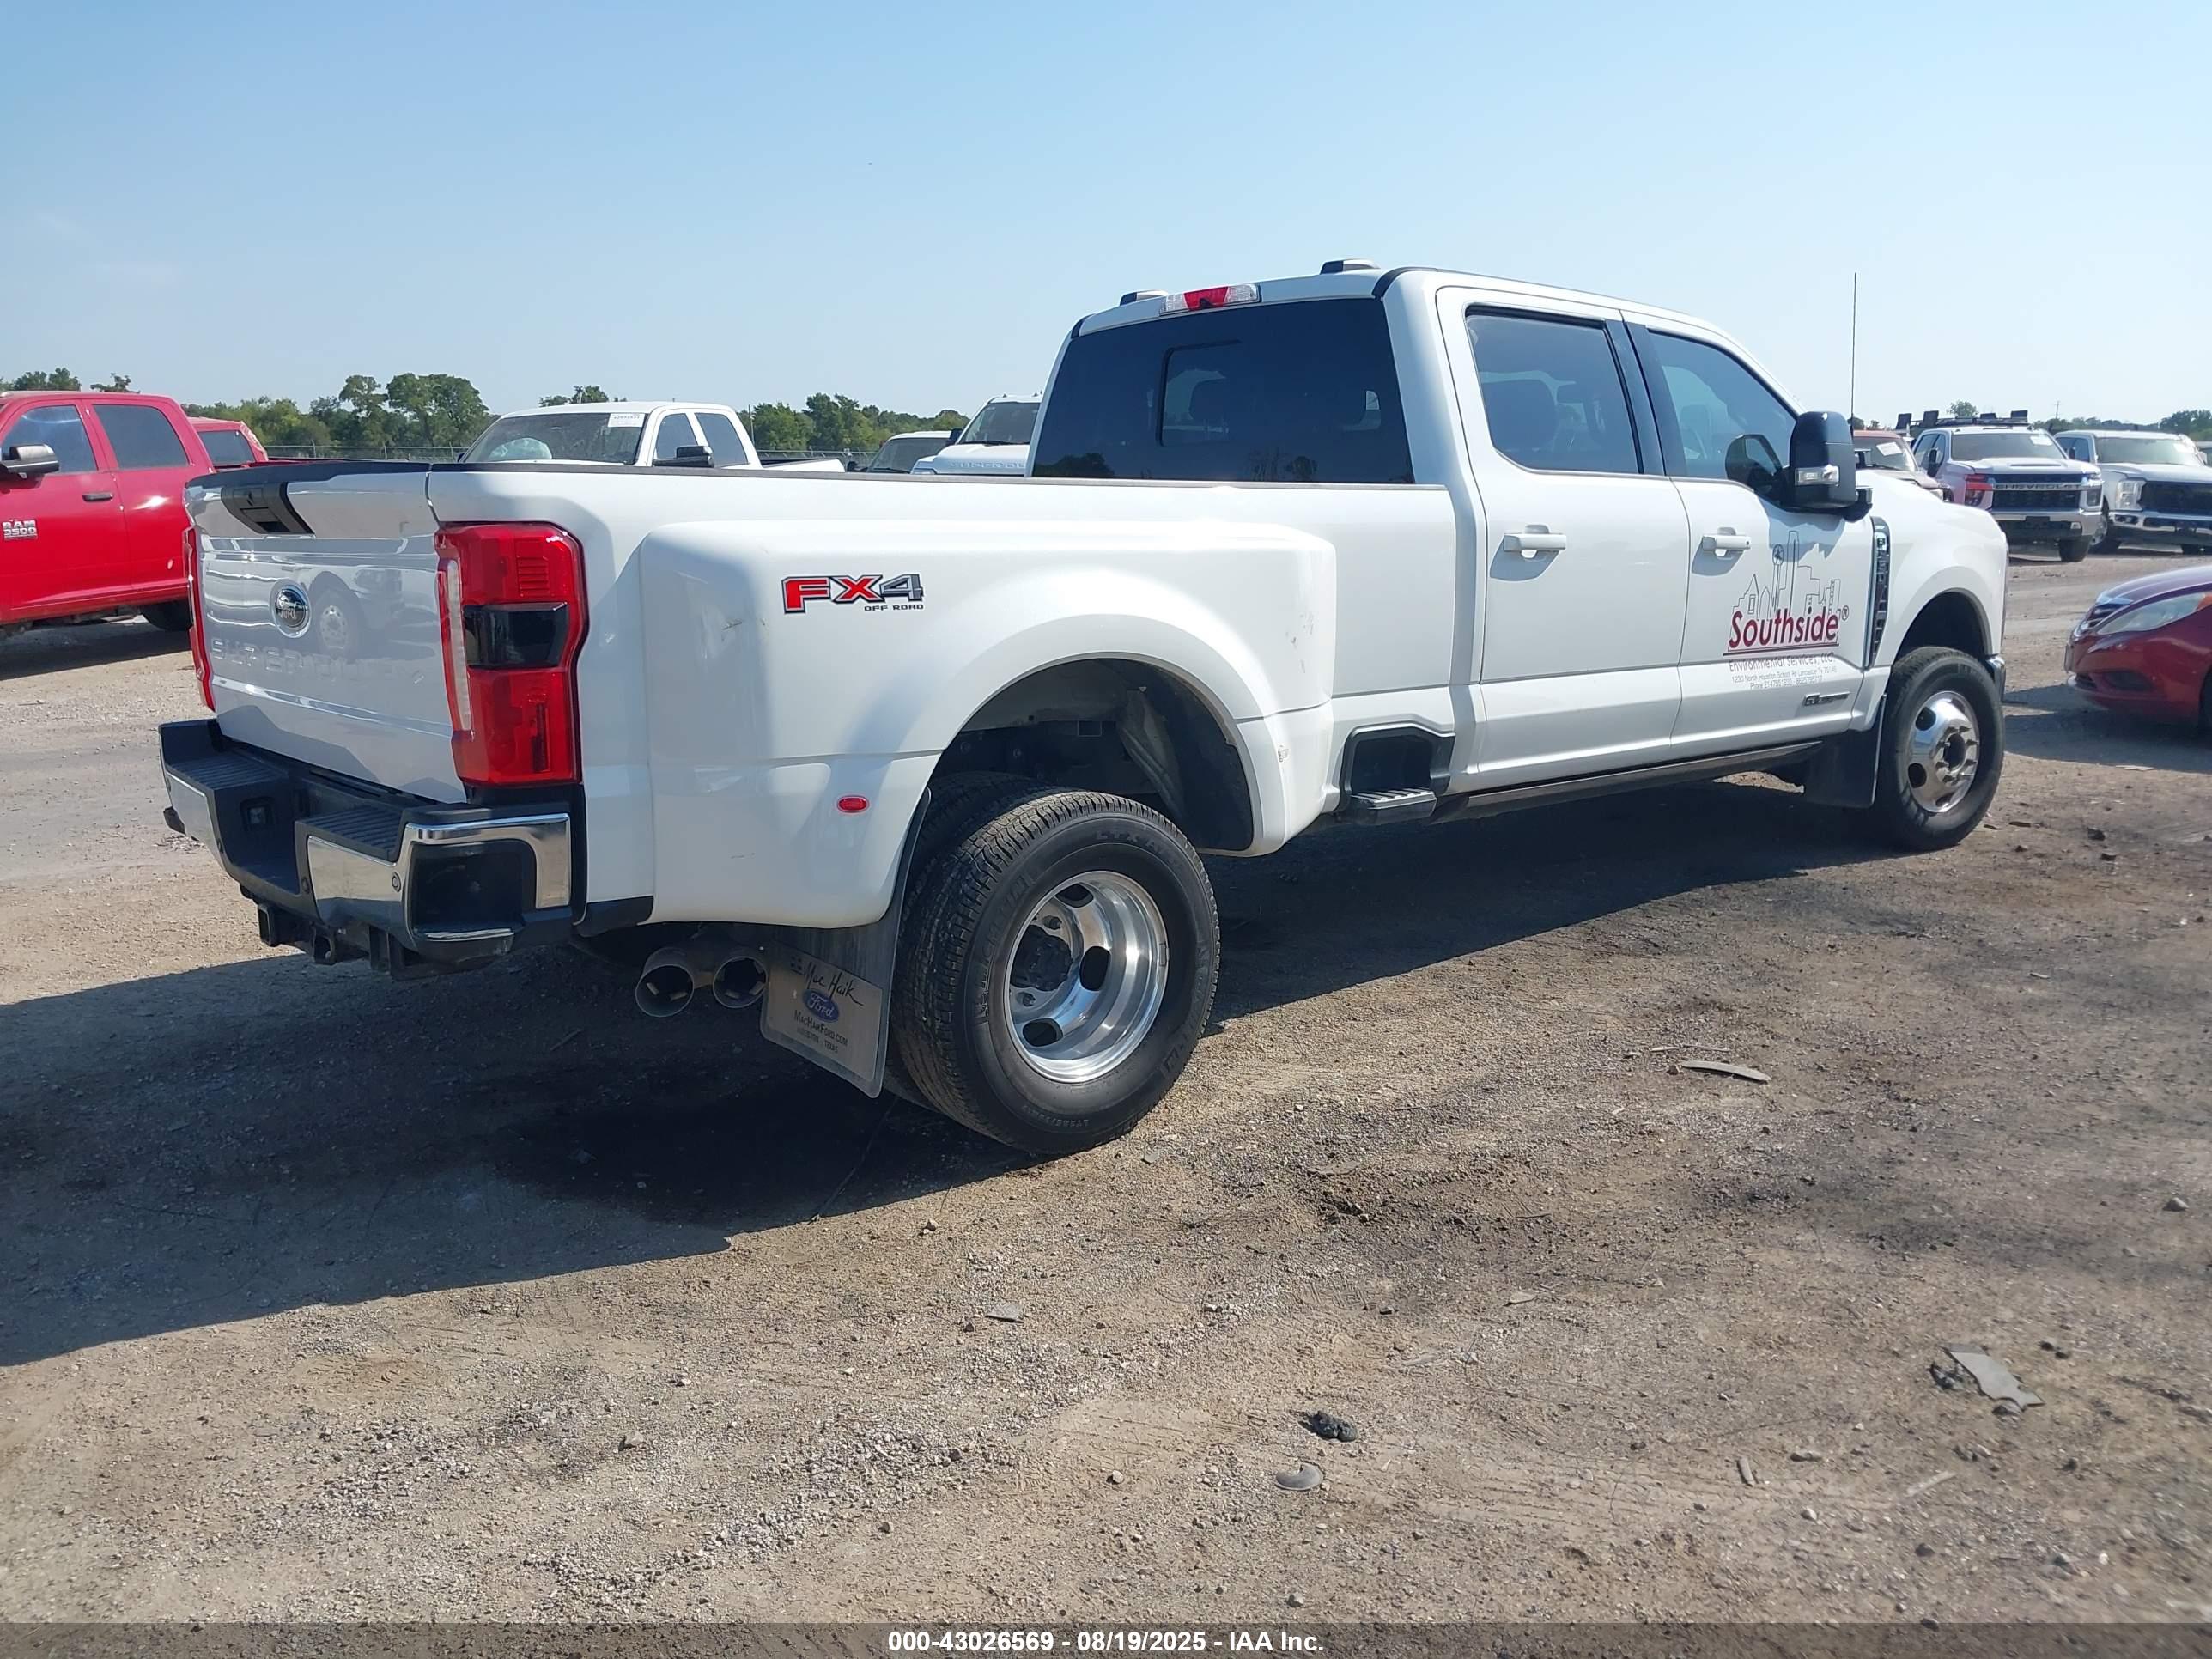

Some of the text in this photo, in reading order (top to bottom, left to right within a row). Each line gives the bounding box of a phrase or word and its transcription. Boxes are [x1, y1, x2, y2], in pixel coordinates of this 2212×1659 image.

[3, 520, 35, 529] RAM
[3, 526, 37, 536] 3500
[781, 574, 924, 614] FX4
[827, 971, 865, 1006] Haik
[810, 993, 834, 1018] Ford
